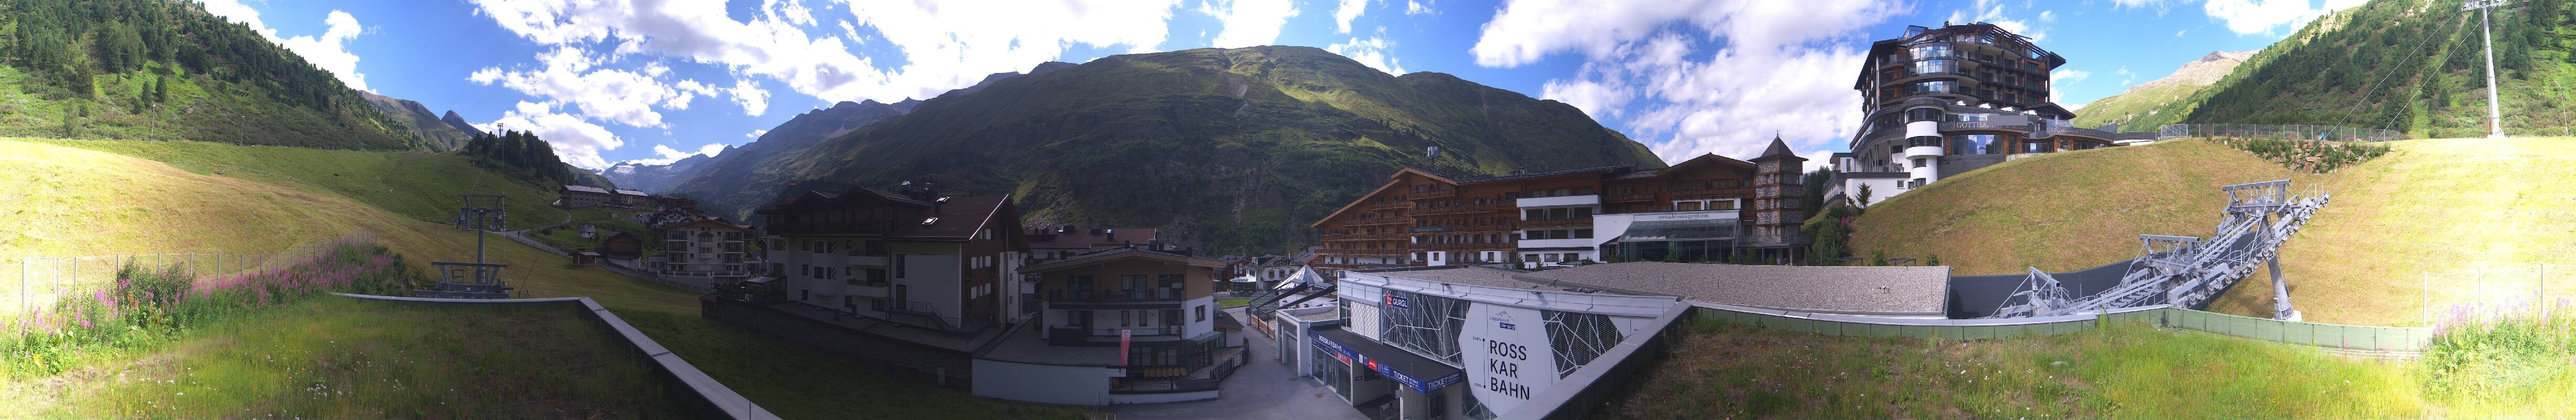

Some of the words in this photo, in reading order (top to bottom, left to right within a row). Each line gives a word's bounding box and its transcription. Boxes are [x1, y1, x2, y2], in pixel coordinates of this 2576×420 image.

[1393, 298, 1407, 307] GURGL
[1319, 335, 1342, 352] ROSSKARBAHN
[1490, 340, 1526, 361] ROSS
[1394, 371, 1409, 383] TICKET
[1490, 359, 1518, 379] KAR
[1427, 377, 1448, 389] TICKET
[1491, 377, 1530, 400] BAHN
